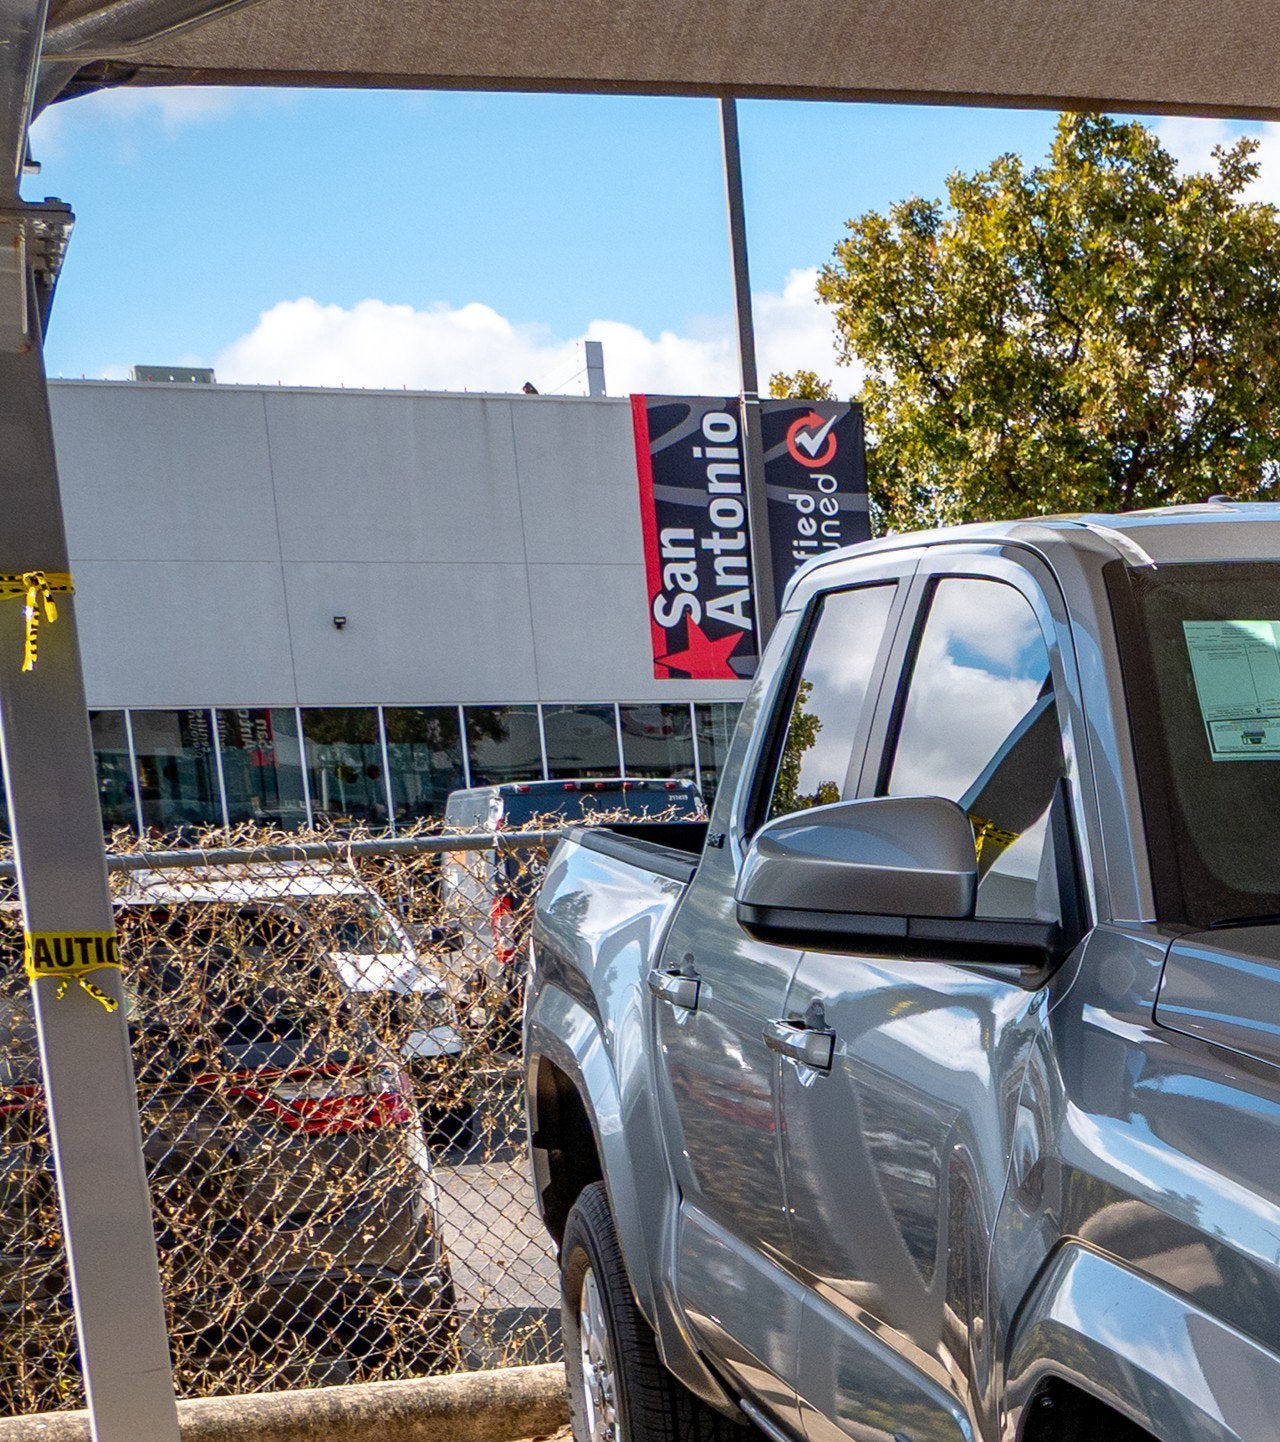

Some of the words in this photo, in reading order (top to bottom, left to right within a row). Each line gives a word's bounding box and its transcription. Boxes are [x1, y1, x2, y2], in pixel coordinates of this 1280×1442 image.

[692, 411, 753, 631] Antonio
[788, 493, 819, 570] fied
[654, 527, 701, 628] San
[26, 937, 121, 968] AUTIO
